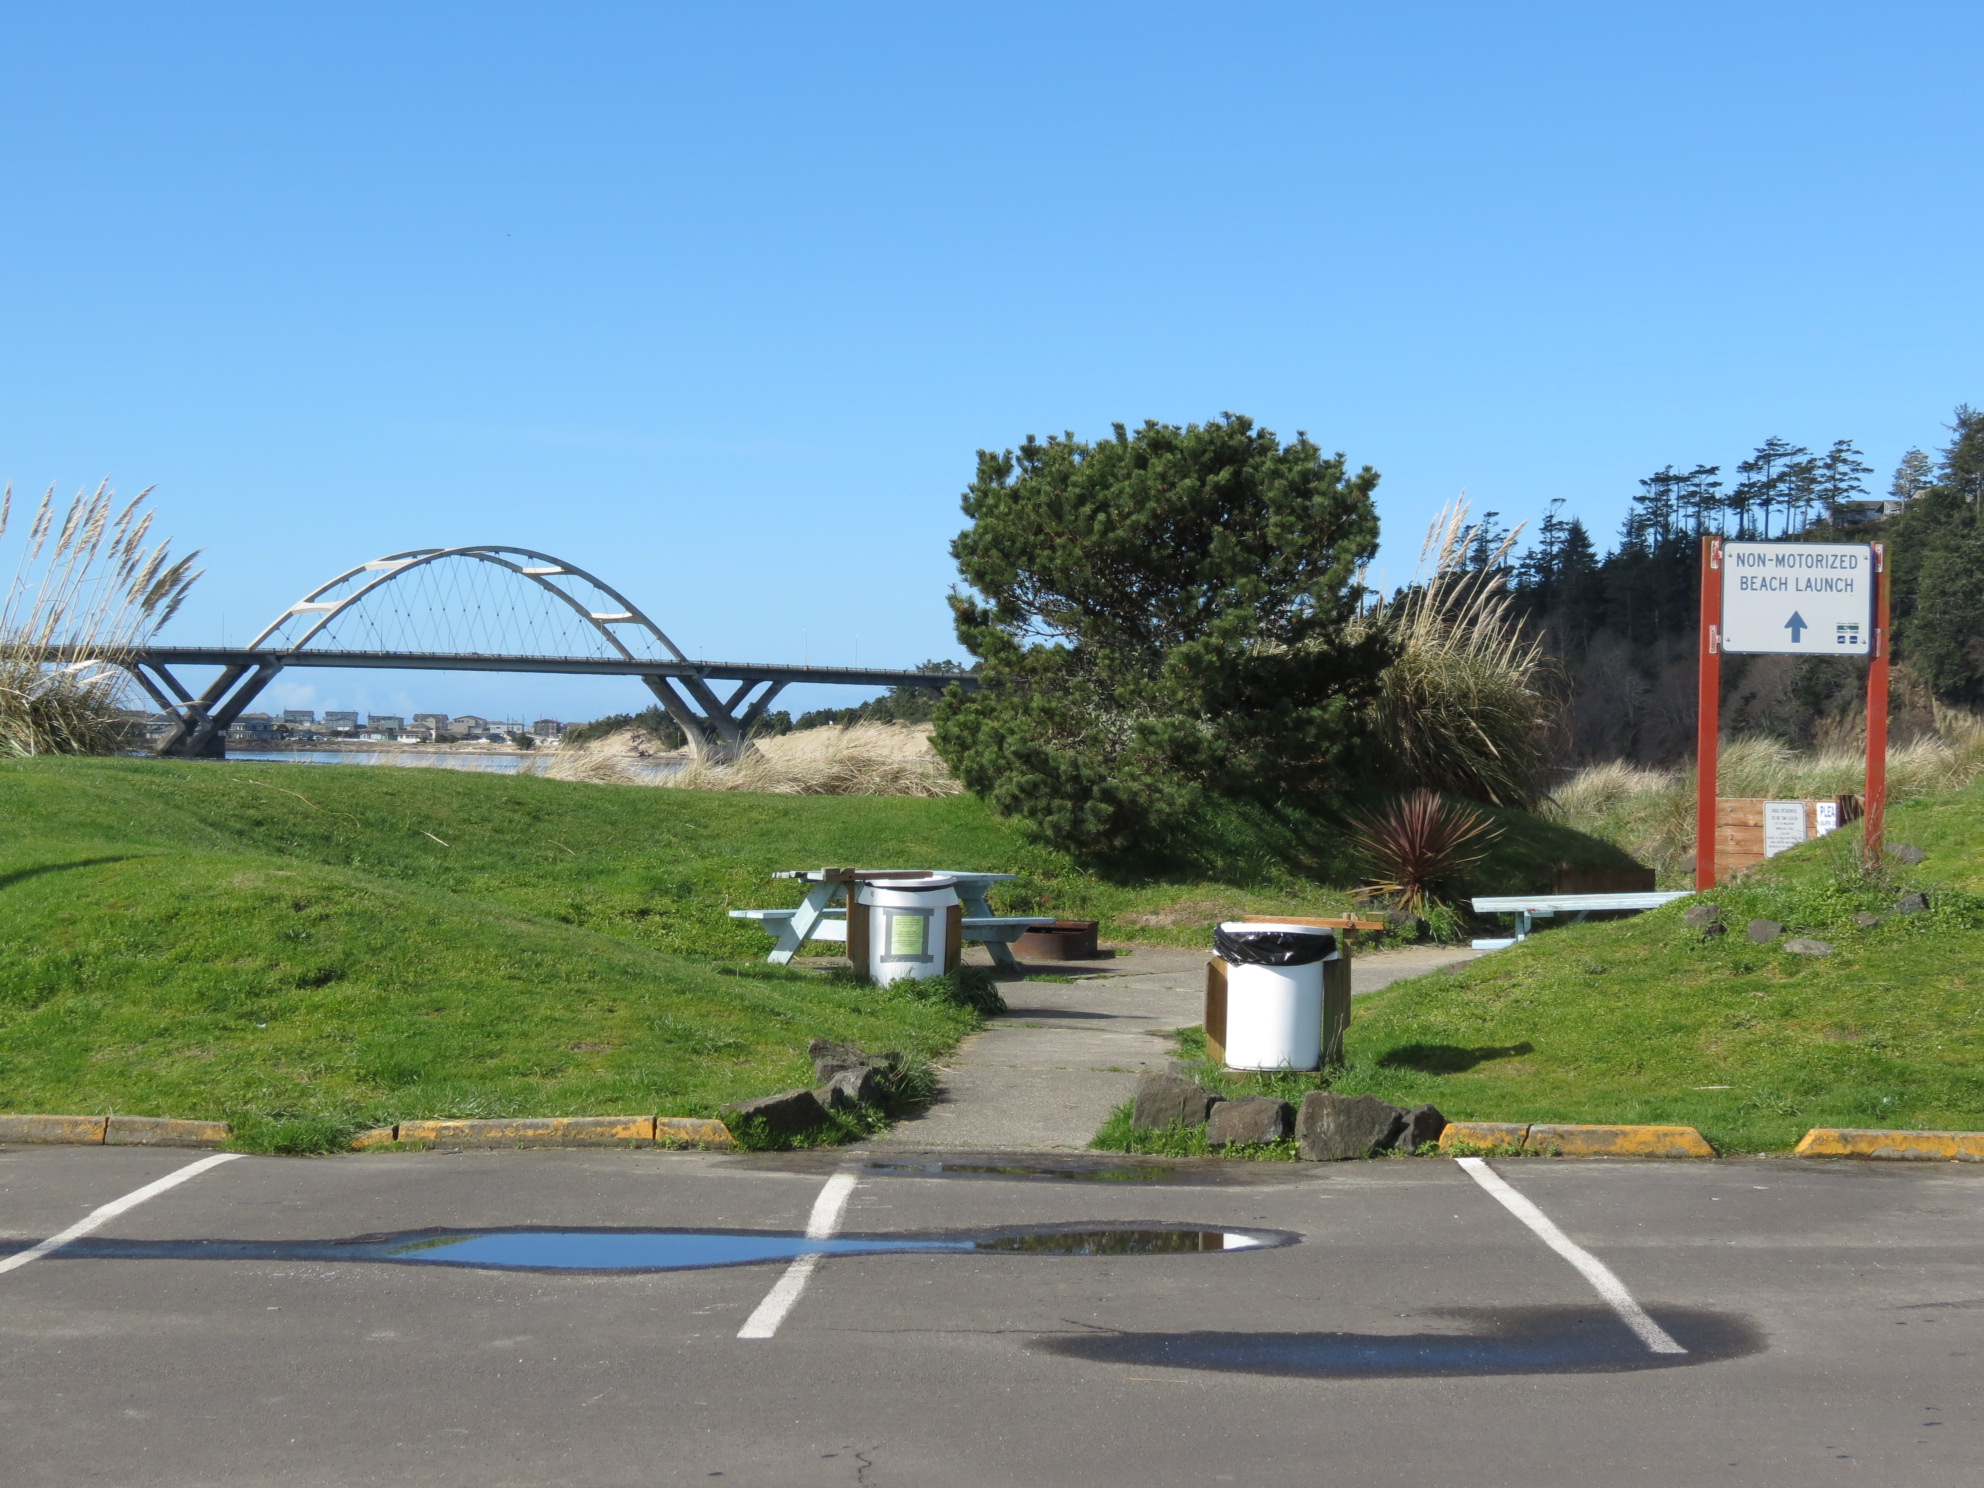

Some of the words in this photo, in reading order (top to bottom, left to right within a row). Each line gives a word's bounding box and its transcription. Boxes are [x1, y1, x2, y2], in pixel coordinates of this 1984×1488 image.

[1736, 552, 1858, 570] NON-MOTORIZED
[1740, 575, 1788, 592] BEACH
[1795, 577, 1854, 593] LAUNCH
[1820, 805, 1836, 818] PLEA
